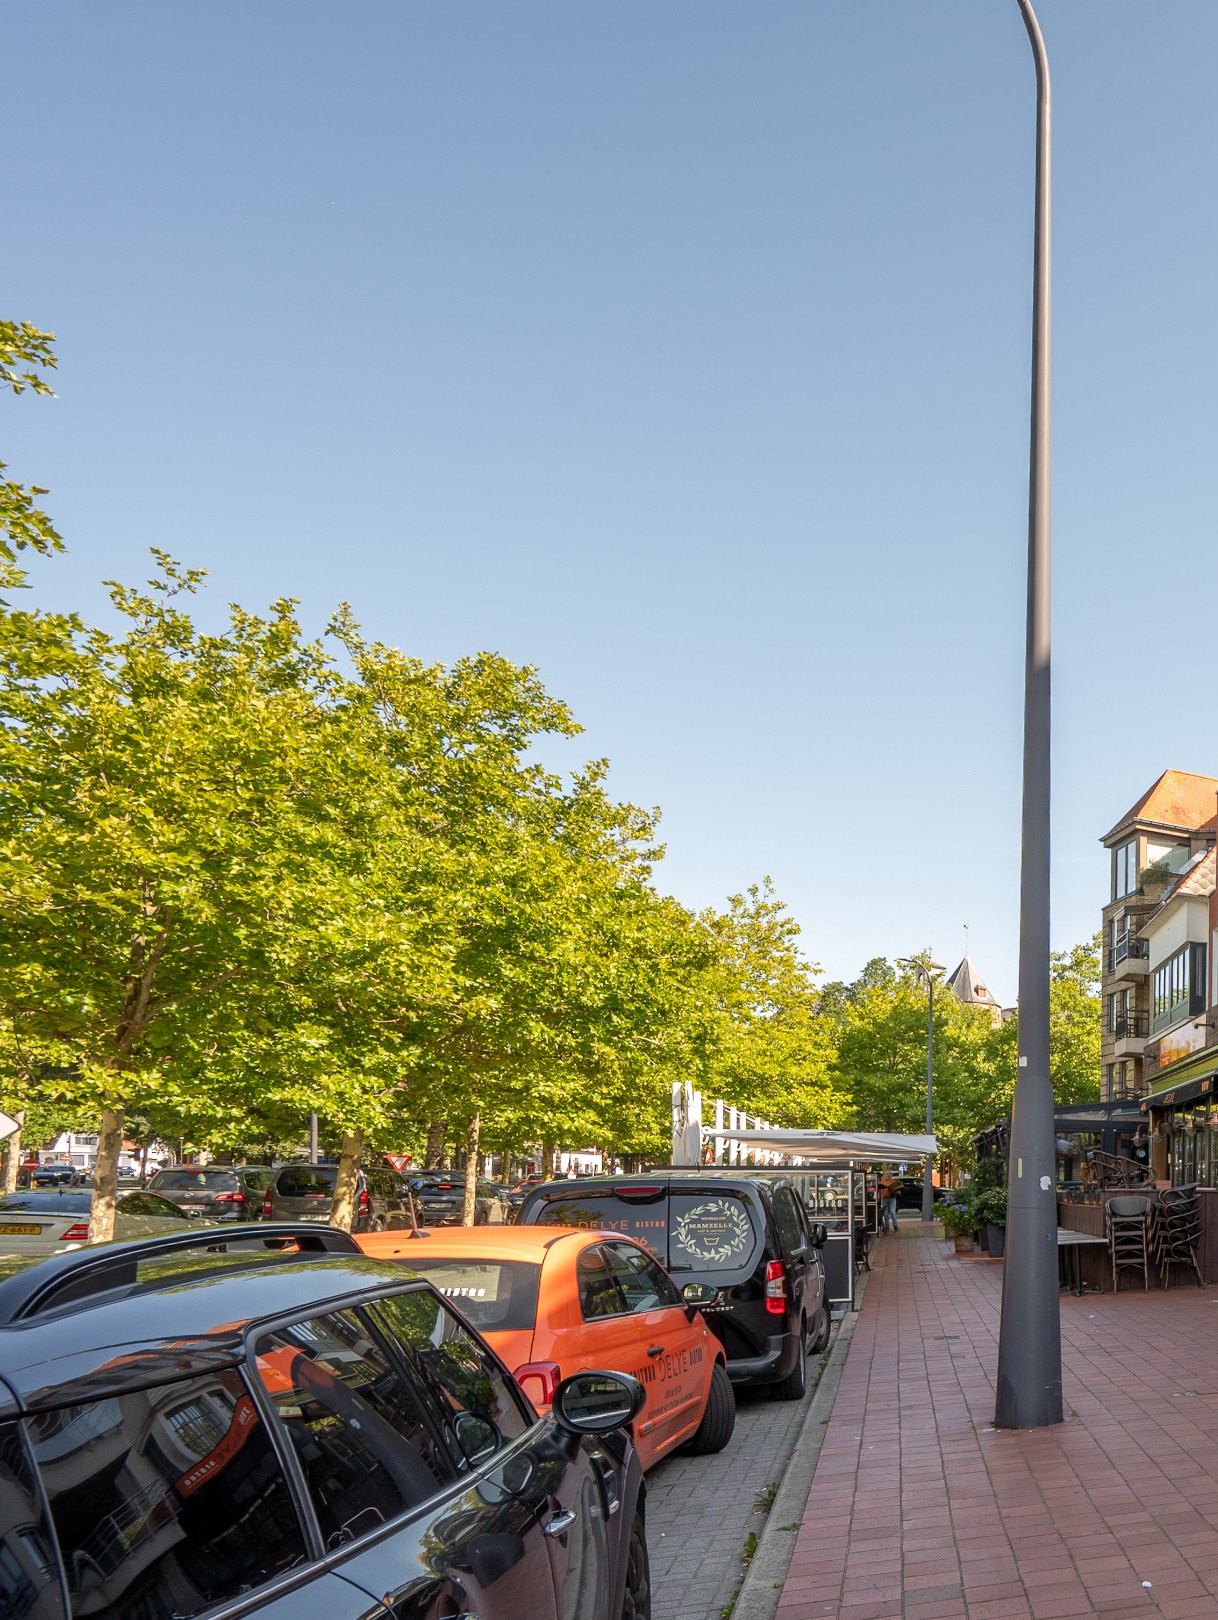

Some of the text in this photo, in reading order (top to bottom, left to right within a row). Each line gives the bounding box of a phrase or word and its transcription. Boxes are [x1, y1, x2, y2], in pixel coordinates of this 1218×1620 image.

[808, 1199, 843, 1208] BISTRO
[635, 1220, 665, 1228] BISTRO
[440, 1287, 486, 1297] BISTRO
[658, 1349, 688, 1383] DELYE
